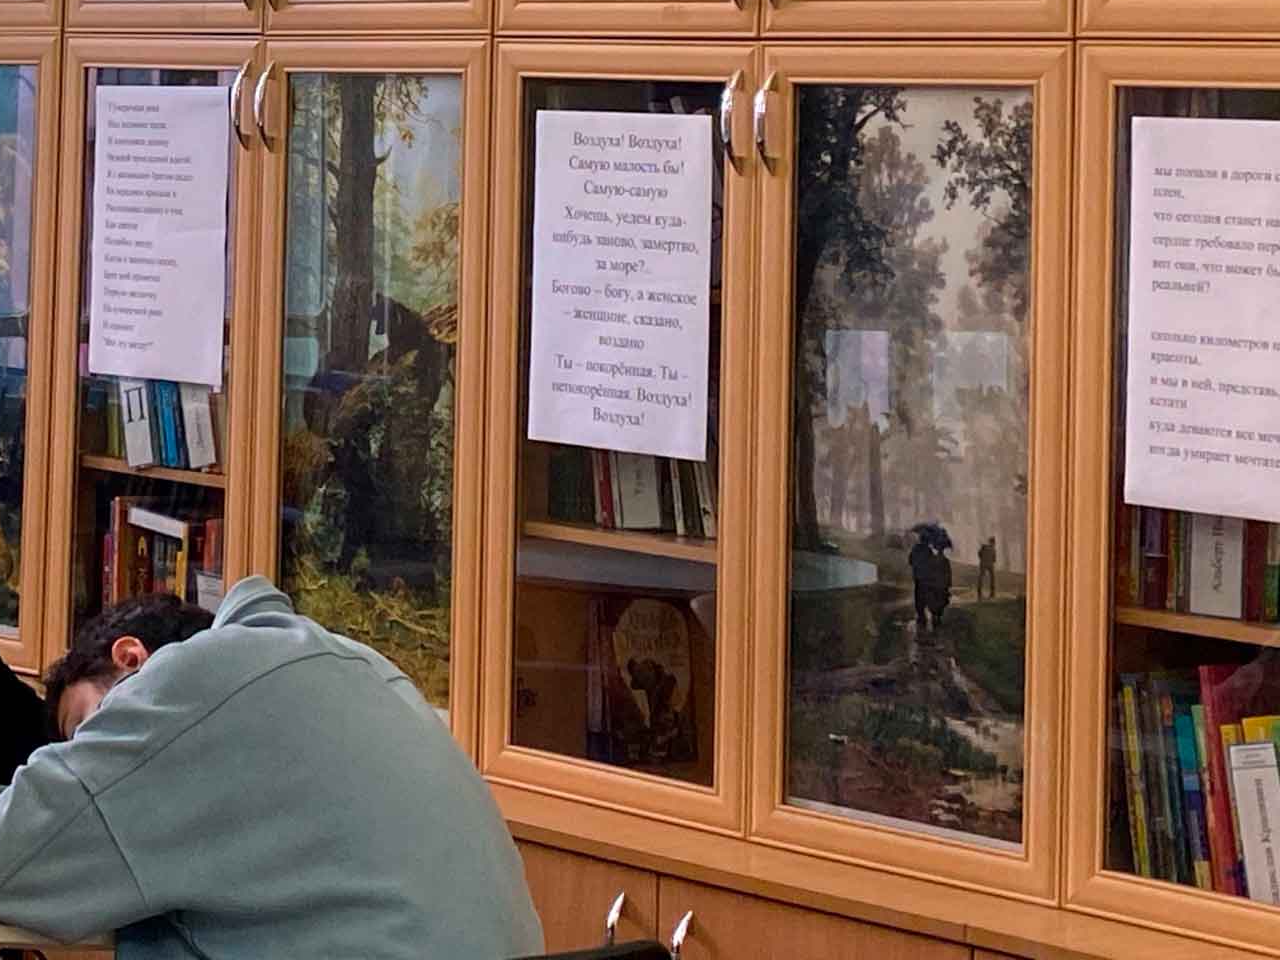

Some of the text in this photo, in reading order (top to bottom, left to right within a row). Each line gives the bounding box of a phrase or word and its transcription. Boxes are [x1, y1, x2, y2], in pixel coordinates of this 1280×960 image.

[572, 131, 682, 152] Воздуха! Воздуха!
[568, 154, 610, 173] Самую
[613, 161, 660, 174] малость
[583, 179, 669, 201] Самую-самую
[616, 211, 652, 226] уедем
[646, 291, 697, 306] женское
[633, 314, 683, 331] сказано,
[554, 353, 573, 369] Ты
[660, 365, 678, 381] Ты
[124, 386, 148, 423] П
[635, 386, 692, 408] Воздуха!
[592, 407, 646, 429] Воздуха!
